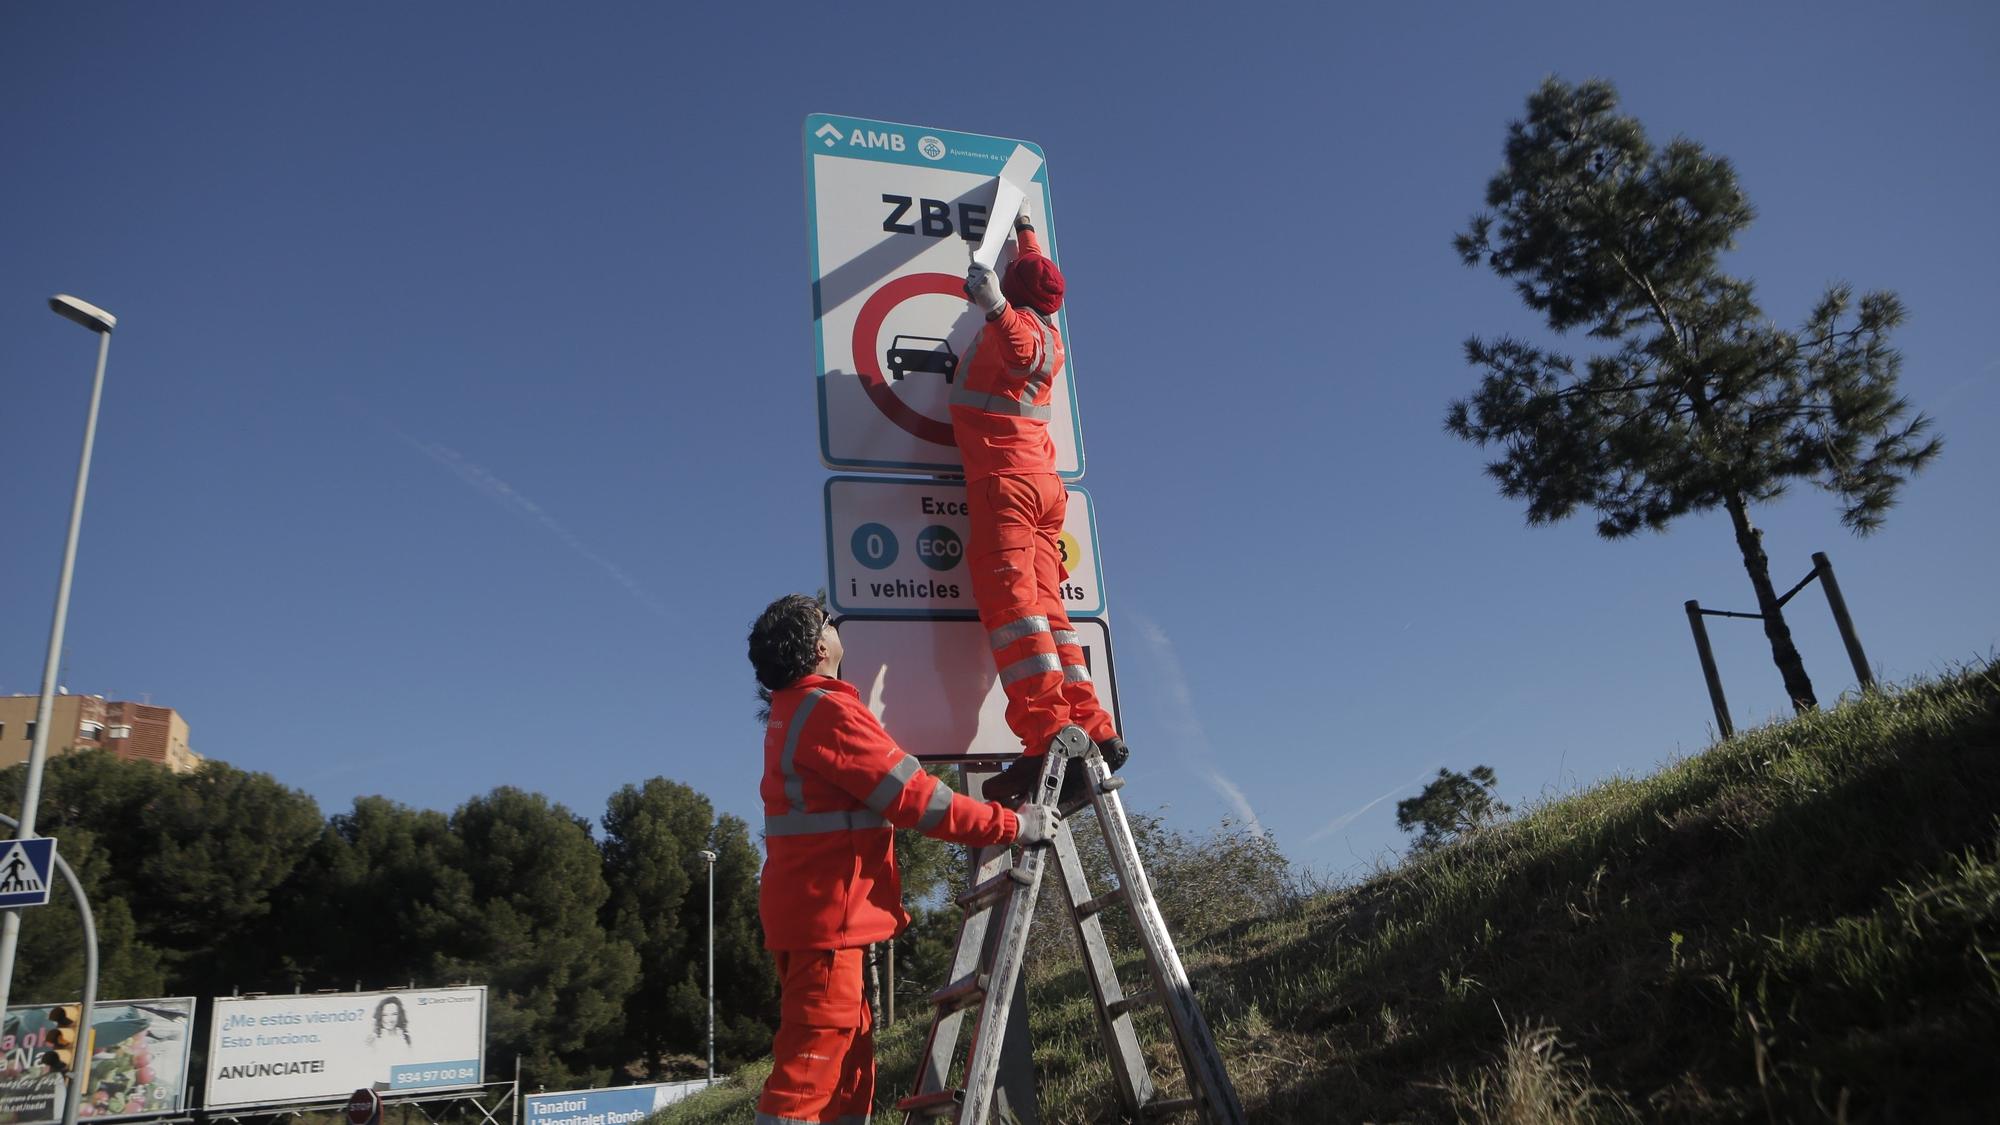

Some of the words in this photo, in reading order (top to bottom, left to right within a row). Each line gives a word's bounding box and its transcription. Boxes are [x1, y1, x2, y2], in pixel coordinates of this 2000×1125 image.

[849, 128, 906, 152] AMB
[950, 148, 989, 160] Ajuntament
[881, 193, 987, 242] ZBE
[921, 496, 968, 516] Exce
[866, 534, 883, 559] 0
[919, 538, 961, 557] ECO
[851, 578, 857, 597] i
[870, 579, 960, 599] vehicles
[1059, 583, 1085, 600] ats
[222, 1014, 256, 1031] ¿Me
[260, 1011, 302, 1026] estás
[305, 1008, 365, 1024] viendo?
[221, 1035, 253, 1049] Esto
[256, 1032, 321, 1047] funciona.
[217, 1060, 325, 1080] ANÚNCIATE!
[397, 1072, 421, 1084] 934
[423, 1070, 439, 1082] 97
[441, 1069, 457, 1080] 00
[458, 1067, 474, 1079] 84
[531, 1097, 587, 1115] Tanatori
[607, 1109, 645, 1125] Ronda
